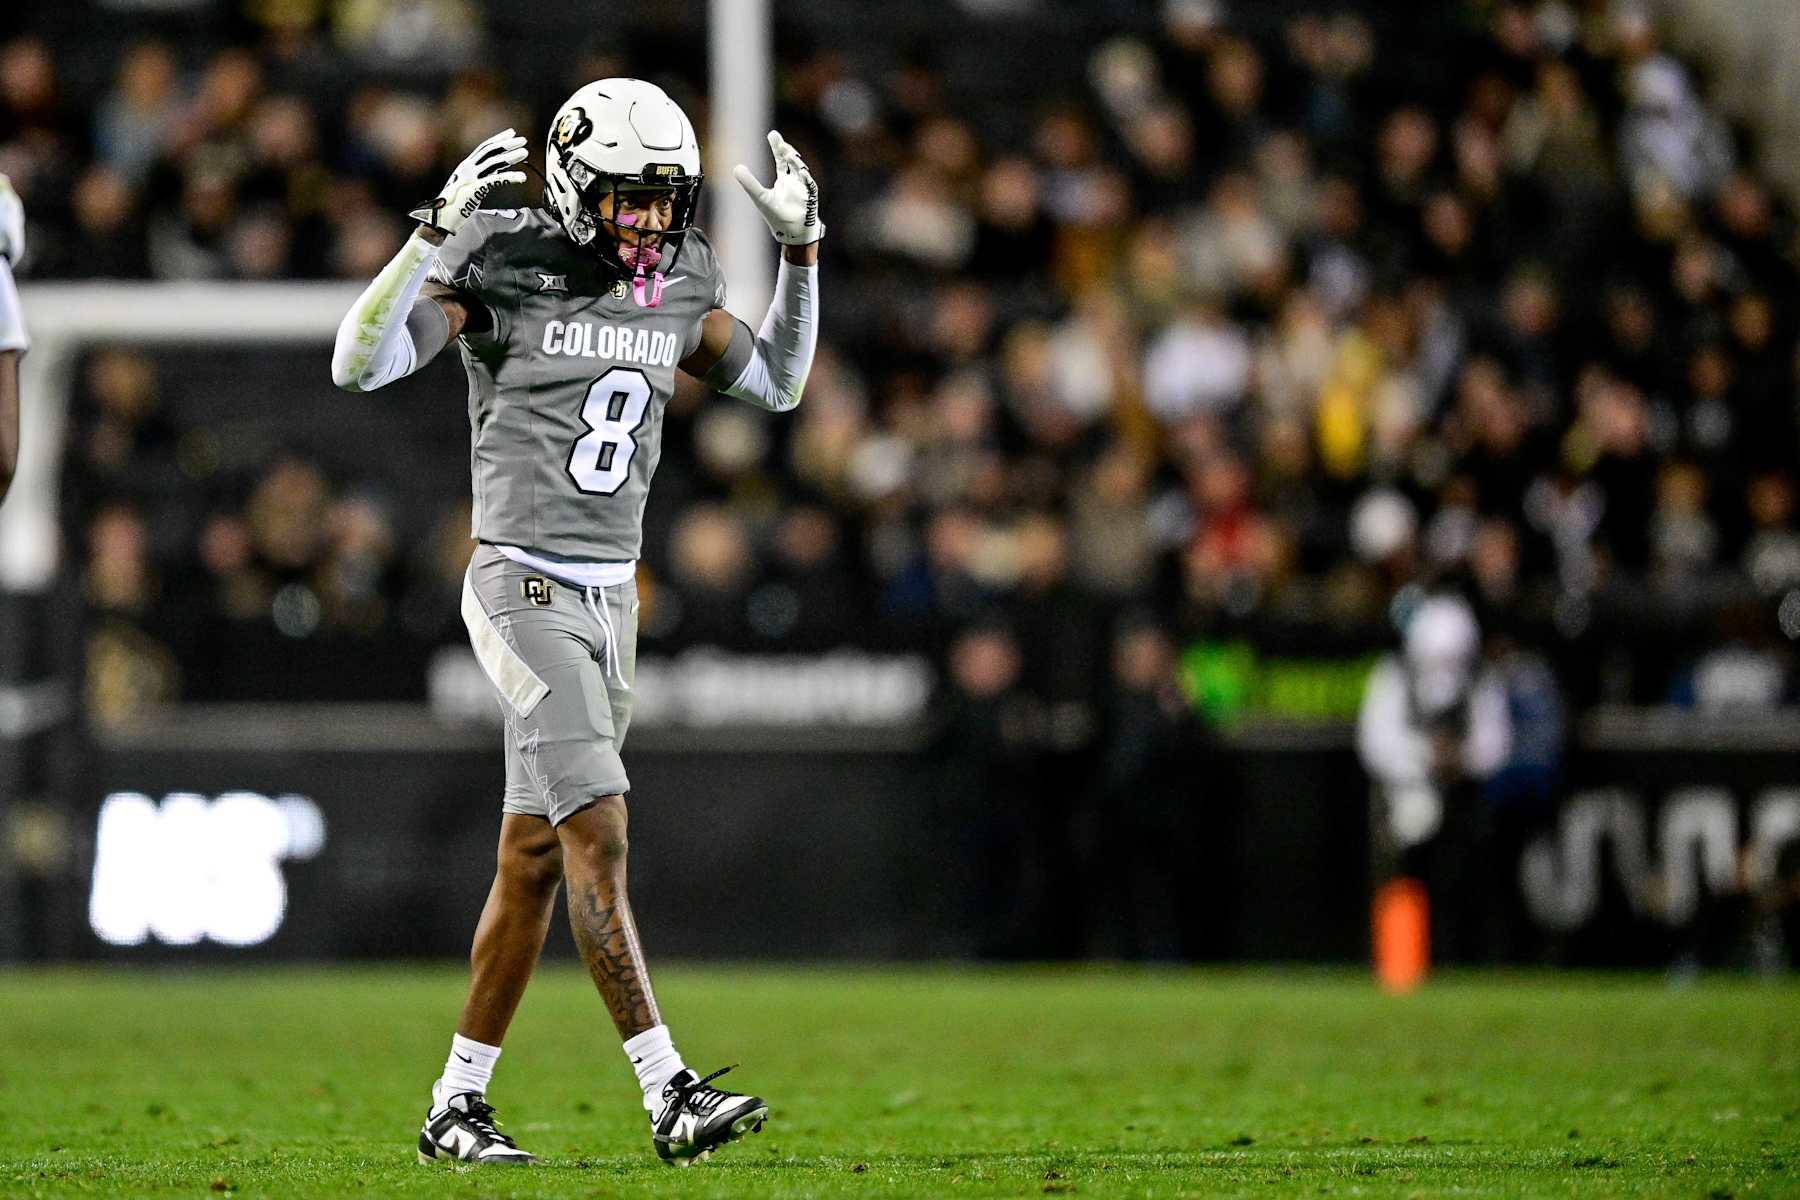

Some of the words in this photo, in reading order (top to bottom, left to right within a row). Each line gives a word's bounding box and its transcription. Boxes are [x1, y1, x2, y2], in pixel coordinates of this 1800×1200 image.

[655, 165, 679, 176] BUFFS
[542, 320, 677, 368] COLORADO
[564, 365, 654, 498] 8
